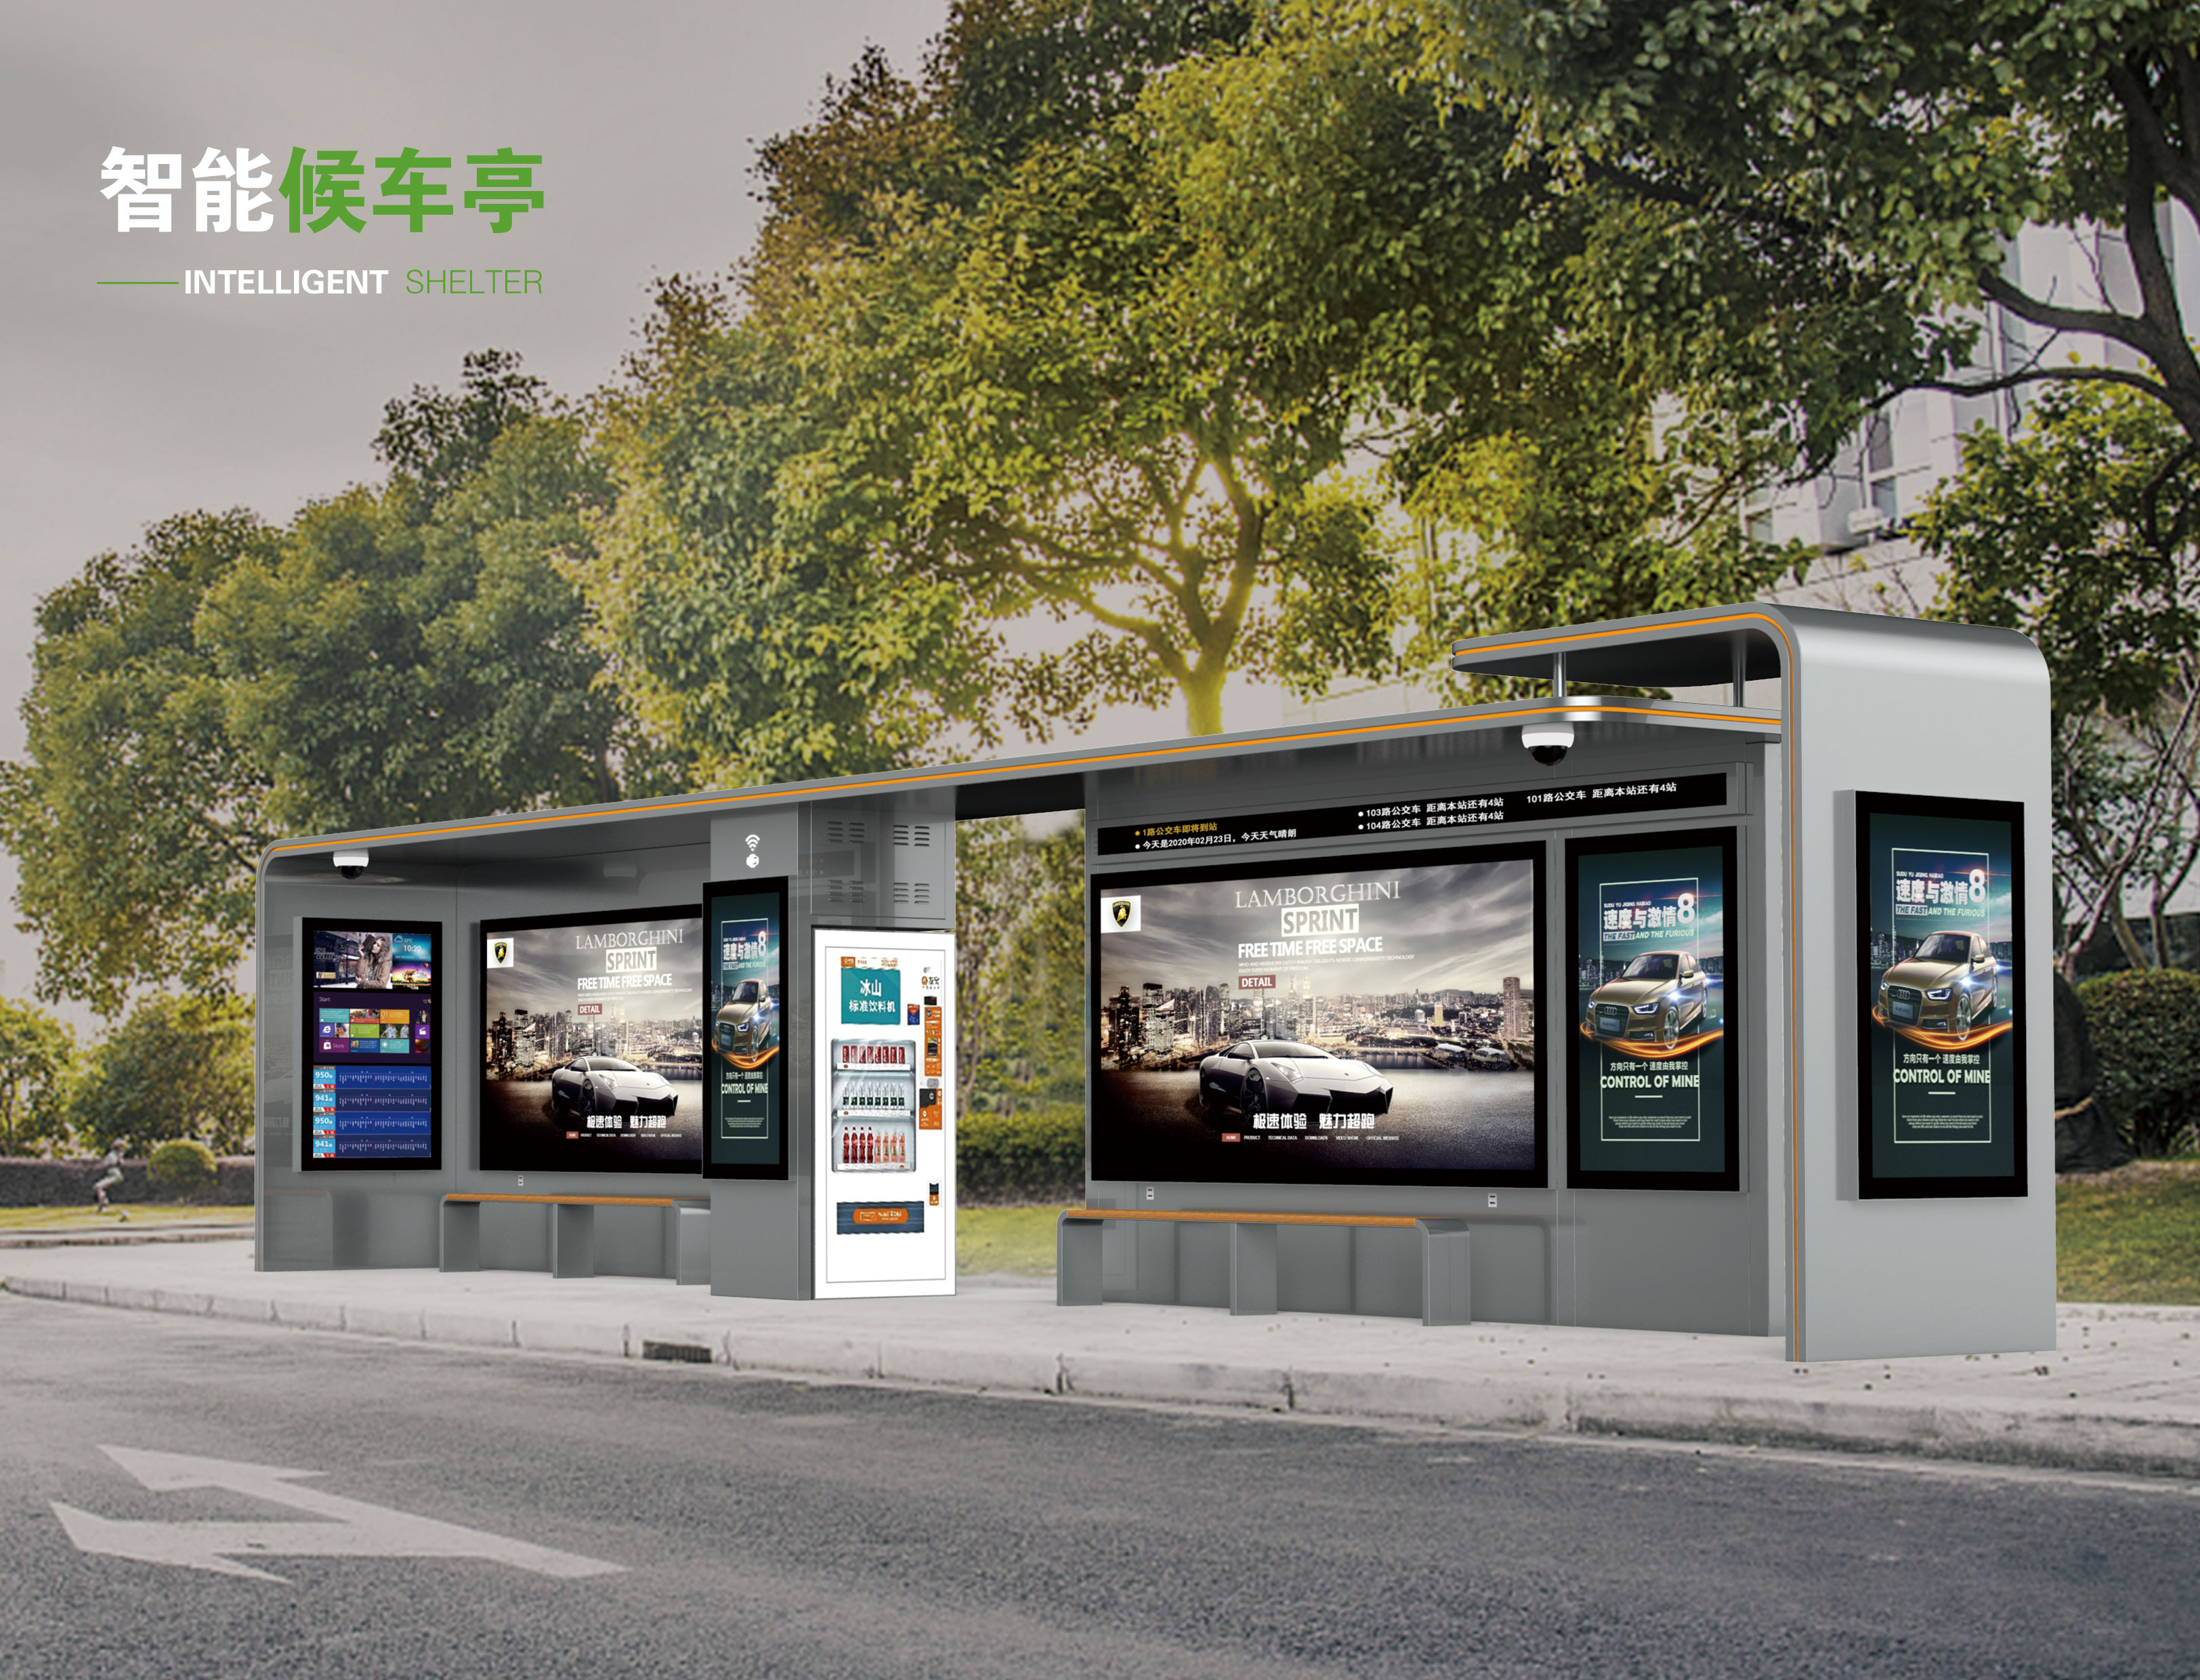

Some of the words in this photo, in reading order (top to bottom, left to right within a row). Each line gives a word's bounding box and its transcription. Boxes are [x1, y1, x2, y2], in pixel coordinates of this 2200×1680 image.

[1526, 790, 1586, 803] 101路公交车
[1592, 782, 1677, 799] 距离本站还有4站
[1366, 804, 1421, 817] 103路公交车
[1426, 797, 1504, 813] 距离本站还有4站
[1366, 818, 1421, 830] 104路公交车
[1426, 811, 1504, 826] 距离本站还有4站
[1143, 822, 1218, 837] 1路公交车即将到站
[1234, 881, 1401, 908] LAMBORGHINI
[1957, 908, 1985, 917] FURIOUS
[1284, 908, 1358, 934] SPRINT
[576, 929, 684, 949] LAMBORGHINI
[1665, 929, 1695, 938] FURIOUS
[1238, 943, 1268, 959] FREE
[1269, 941, 1303, 957] TIME
[1305, 939, 1336, 955] FREE
[1339, 936, 1383, 953] SPACE
[608, 950, 656, 971] SPRINT
[578, 978, 597, 990] FREE
[598, 976, 620, 989] TIME
[622, 975, 642, 988] FREE
[643, 973, 672, 986] SPACE
[860, 979, 882, 997] 冰山
[1242, 978, 1272, 988] DETAIL
[580, 1005, 600, 1013] DETAIL
[849, 1000, 895, 1013] 标准饮料机
[1610, 1062, 1647, 1071] 方向只有一个
[1649, 1061, 1688, 1070] 速度由我掌控
[1903, 1053, 1941, 1064] 方向只有一个
[1943, 1053, 1980, 1064] 速度由我掌控
[1600, 1075, 1651, 1088] CONTROL
[1654, 1075, 1669, 1088] OF
[1672, 1075, 1699, 1087] MINE
[1893, 1068, 1945, 1083] CONTROL
[1947, 1069, 1962, 1083] OF
[1964, 1070, 1991, 1084] MINE
[721, 1083, 745, 1094] CONTROL
[746, 1083, 754, 1094] OF
[755, 1083, 768, 1093] MINE
[587, 1115, 622, 1129] 极速体验
[1253, 1112, 1307, 1129] 极速体验
[1319, 1112, 1375, 1129] 魅力超跑
